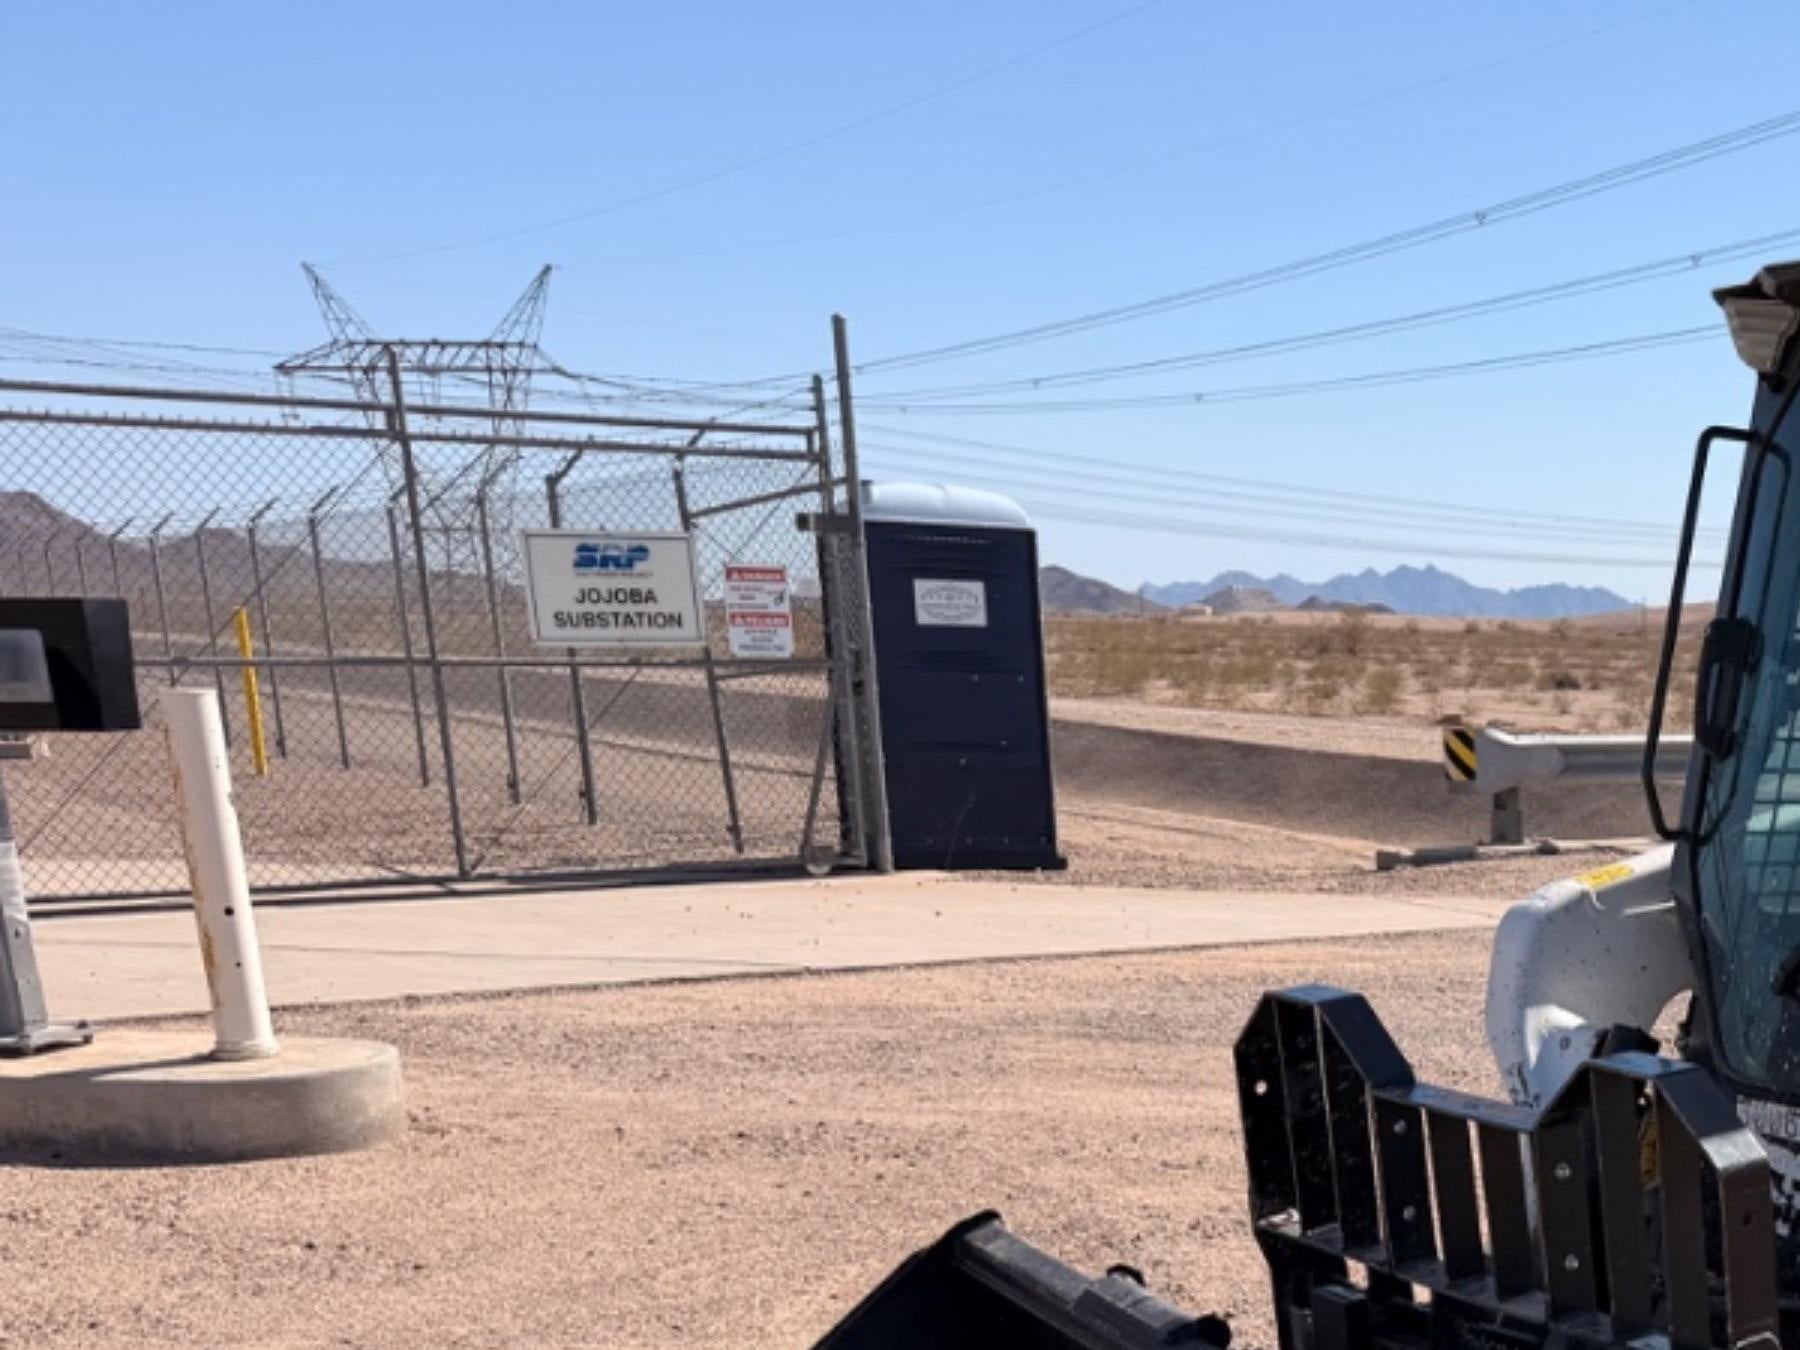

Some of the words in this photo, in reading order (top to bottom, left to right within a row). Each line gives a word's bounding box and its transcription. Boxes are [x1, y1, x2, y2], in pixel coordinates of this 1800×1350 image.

[572, 543, 650, 569] SRP
[574, 586, 659, 605] JOJOBA
[552, 610, 684, 630] SUBSTATION
